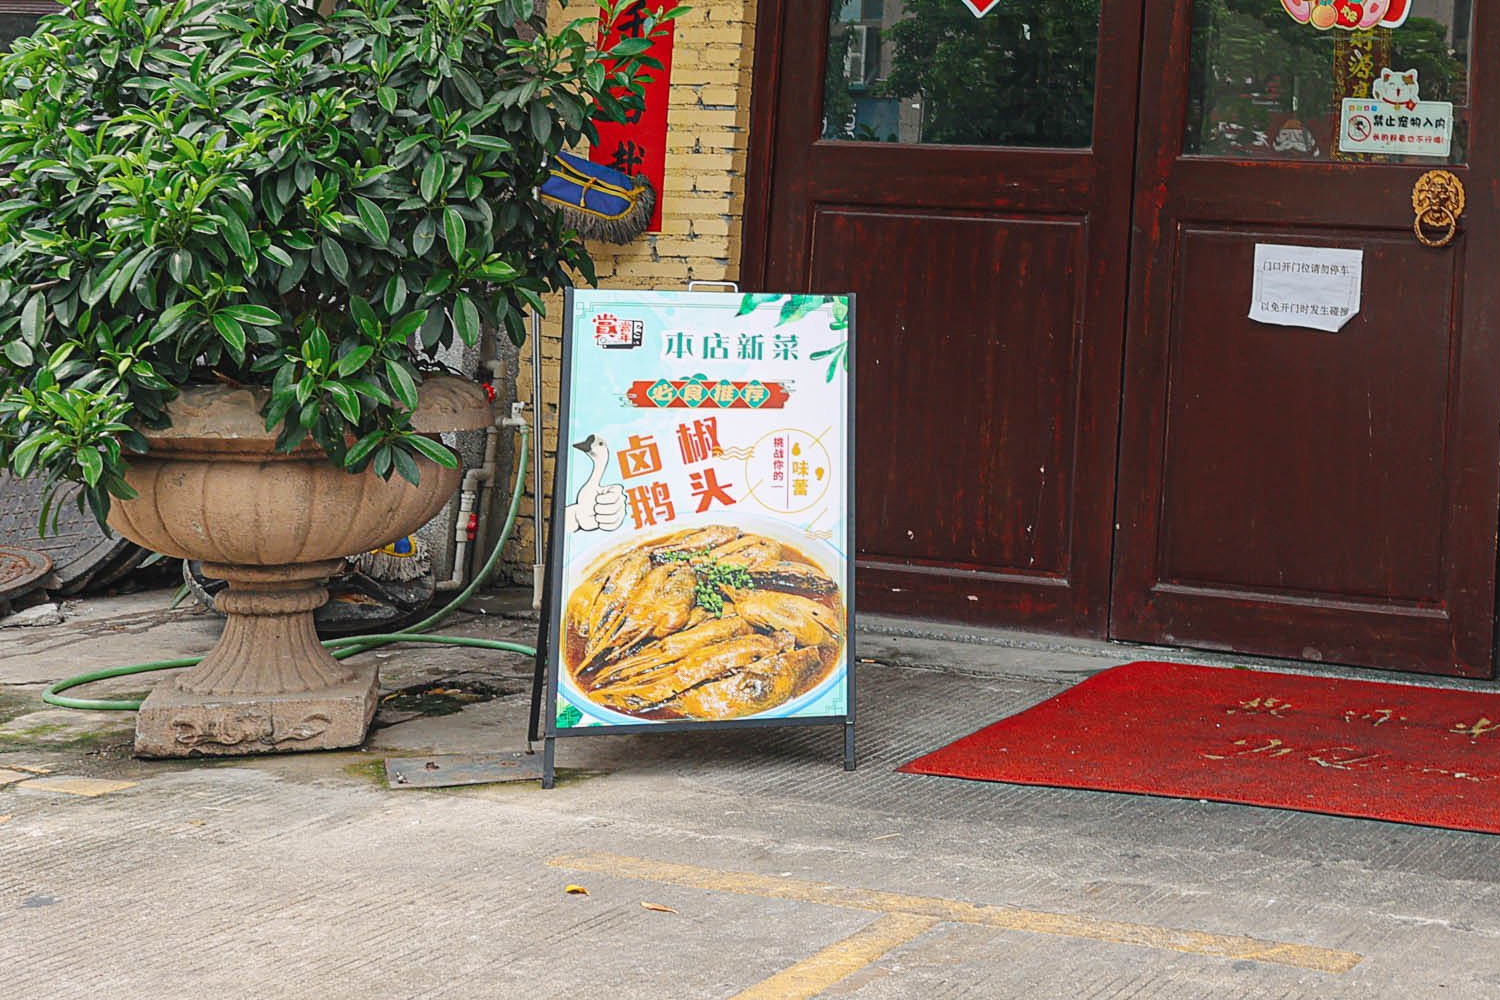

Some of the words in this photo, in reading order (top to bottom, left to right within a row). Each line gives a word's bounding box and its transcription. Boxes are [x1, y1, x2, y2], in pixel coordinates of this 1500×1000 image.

[1373, 115, 1446, 129] 禁止宠物入内
[1263, 261, 1350, 276] 门口开门位请勿停车
[665, 332, 799, 360] 本店新菜
